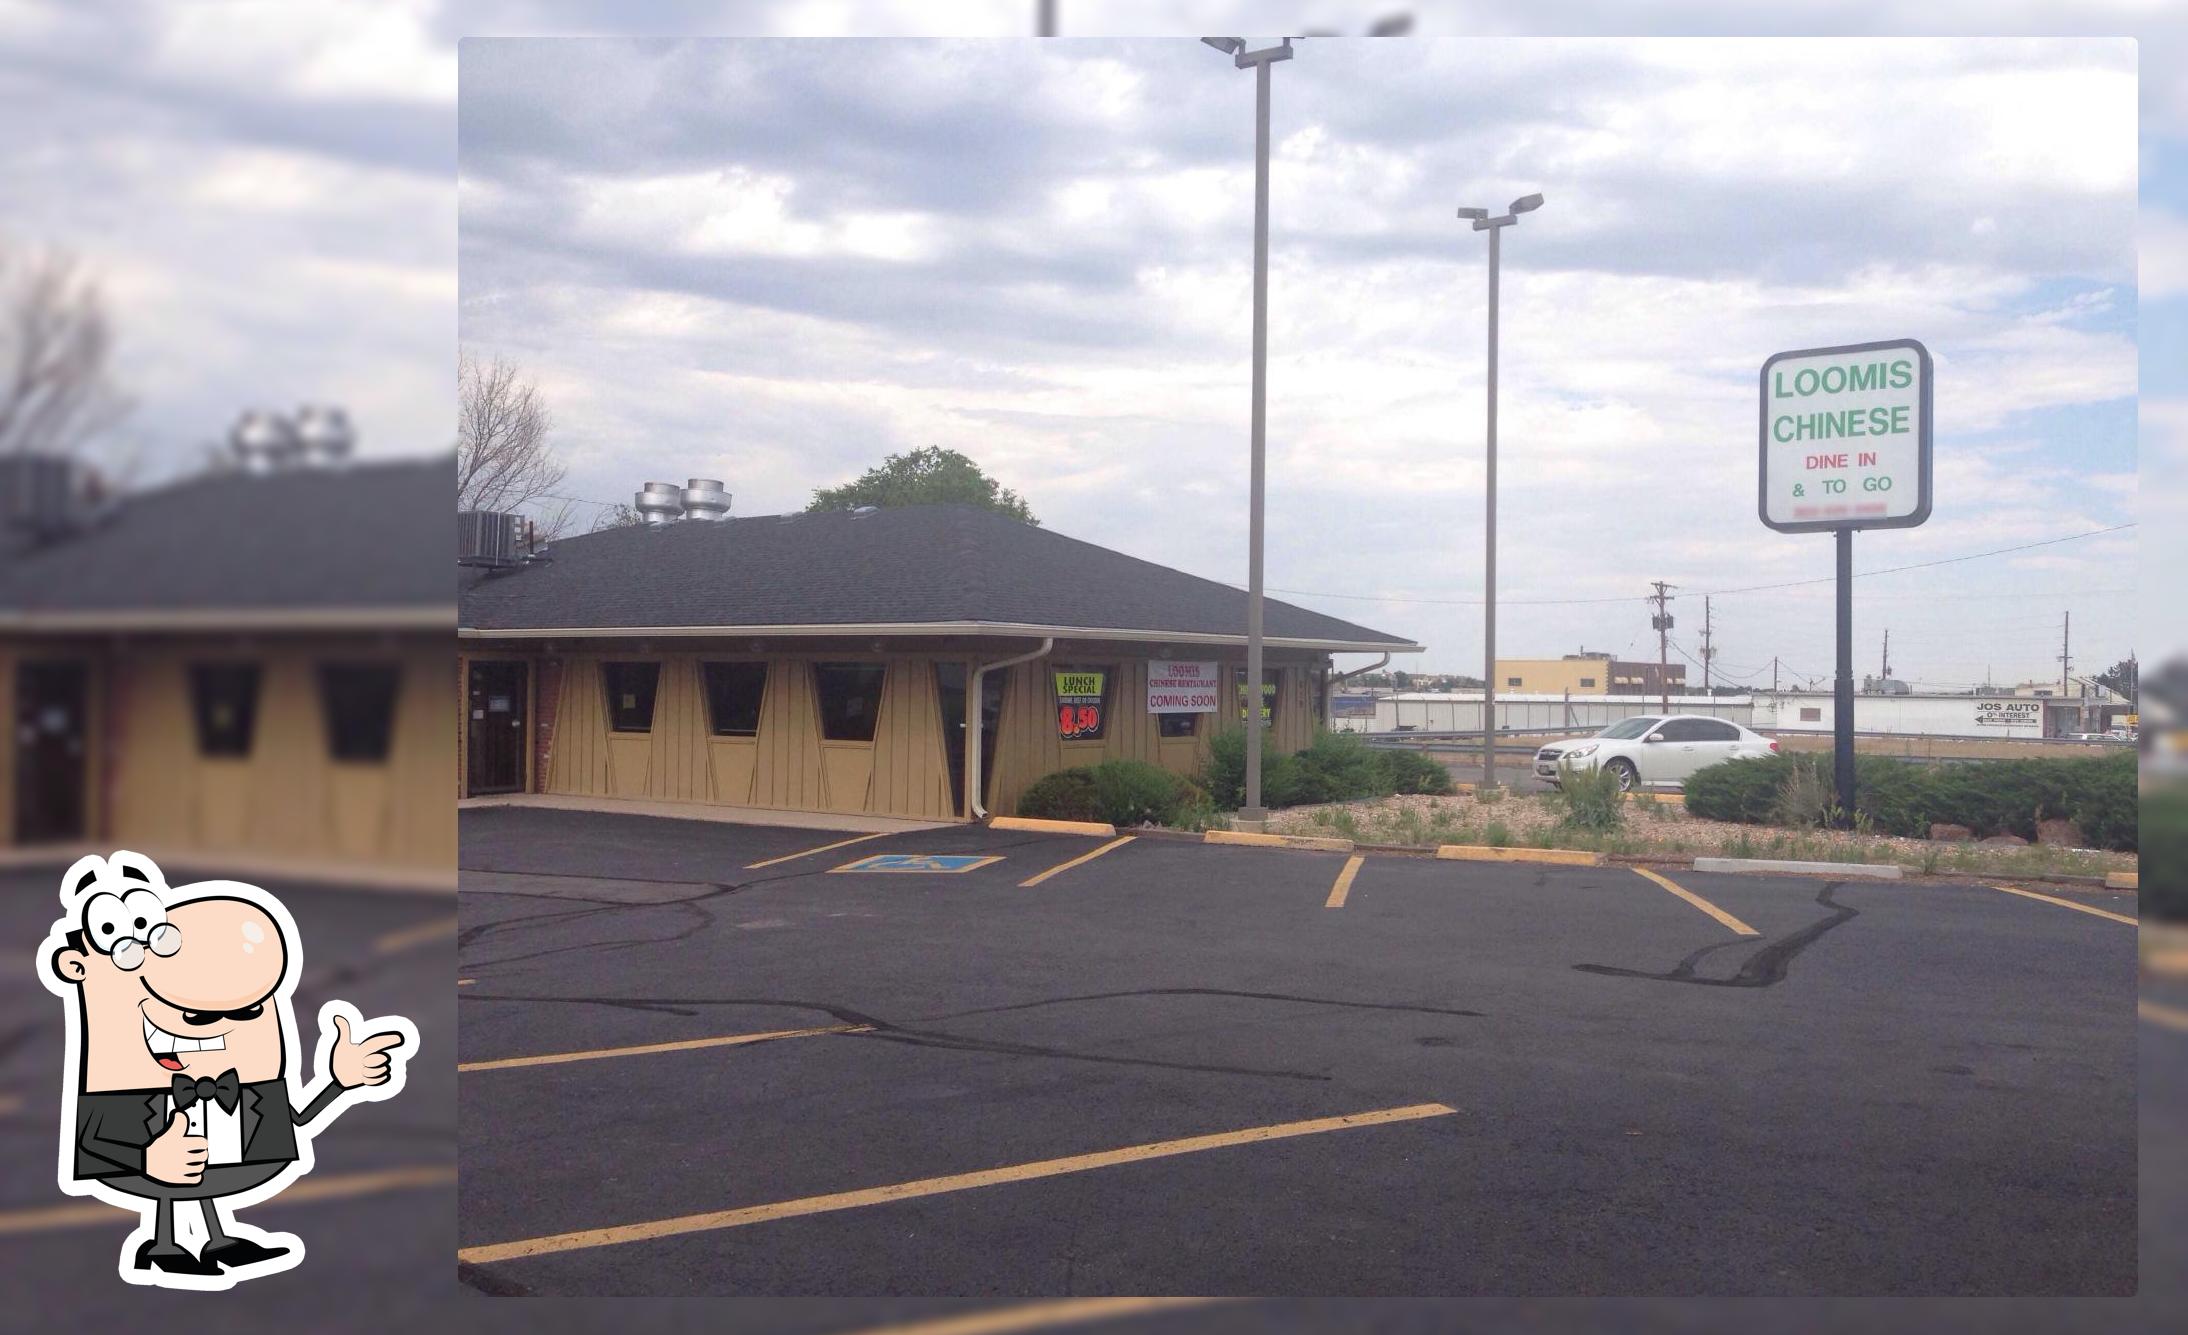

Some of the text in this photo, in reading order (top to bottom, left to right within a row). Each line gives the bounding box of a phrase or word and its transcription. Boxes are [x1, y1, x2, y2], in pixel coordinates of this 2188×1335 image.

[1775, 360, 1913, 399] LOOMIS
[1773, 406, 1910, 443] CHINESE
[1806, 452, 1876, 470] DINE IN
[1792, 476, 1892, 497] & TO GO
[1168, 664, 1200, 677] LOOMIS
[1064, 676, 1095, 686] LUNCH
[1149, 679, 1216, 688] CHINESE RESTAURANT
[1063, 685, 1096, 694] SPECIAL
[1150, 695, 1216, 707] COMING SOON
[1977, 703, 2040, 712] JOS AUTO
[1060, 704, 1099, 737] 8.50
